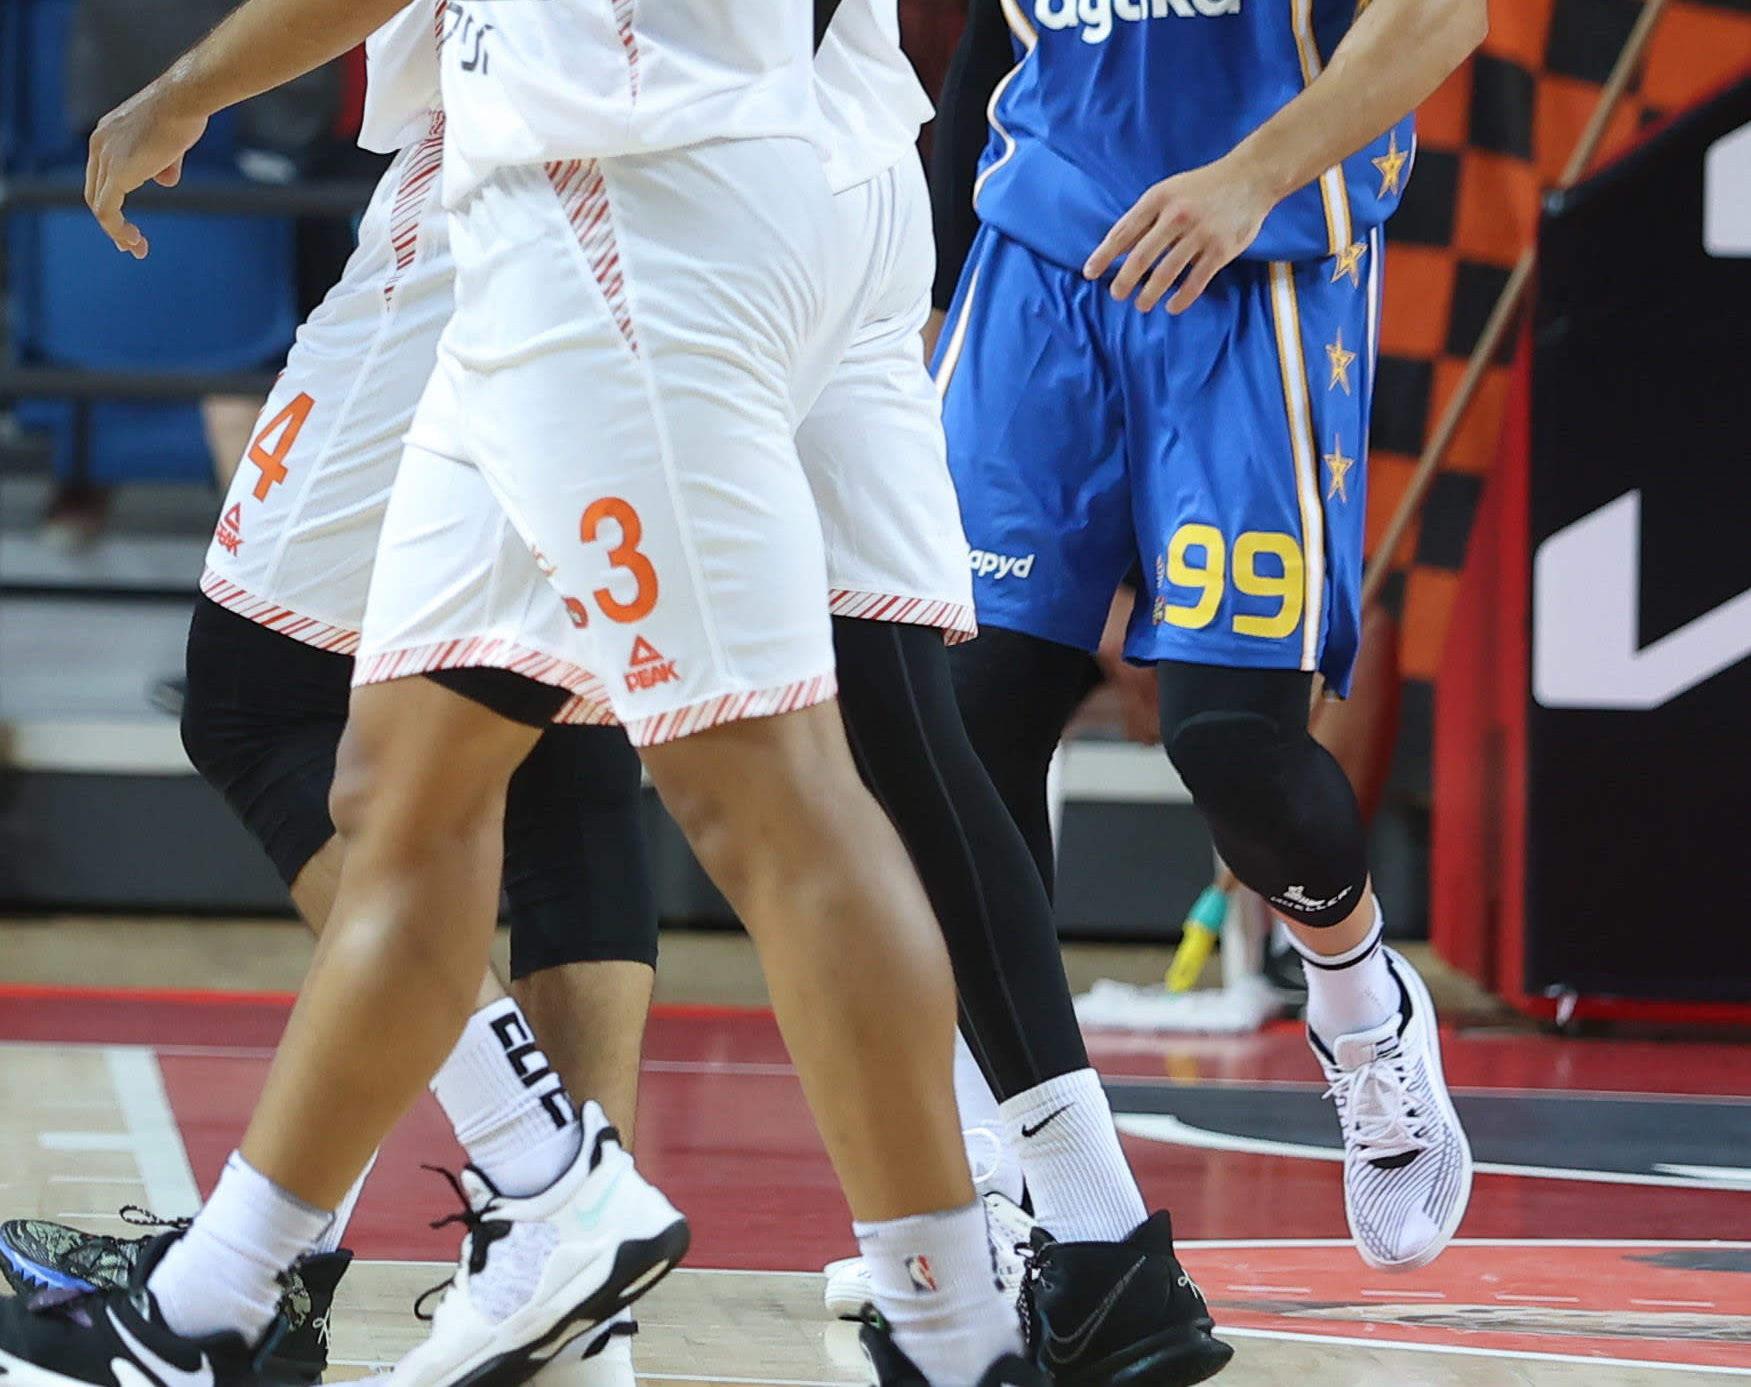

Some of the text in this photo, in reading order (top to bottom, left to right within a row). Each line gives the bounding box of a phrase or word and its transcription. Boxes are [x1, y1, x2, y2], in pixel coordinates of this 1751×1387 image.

[248, 391, 316, 503] 4
[580, 496, 660, 624] 3
[968, 549, 1036, 580] apyd
[1166, 523, 1305, 639] 99
[623, 659, 682, 694] PEAK
